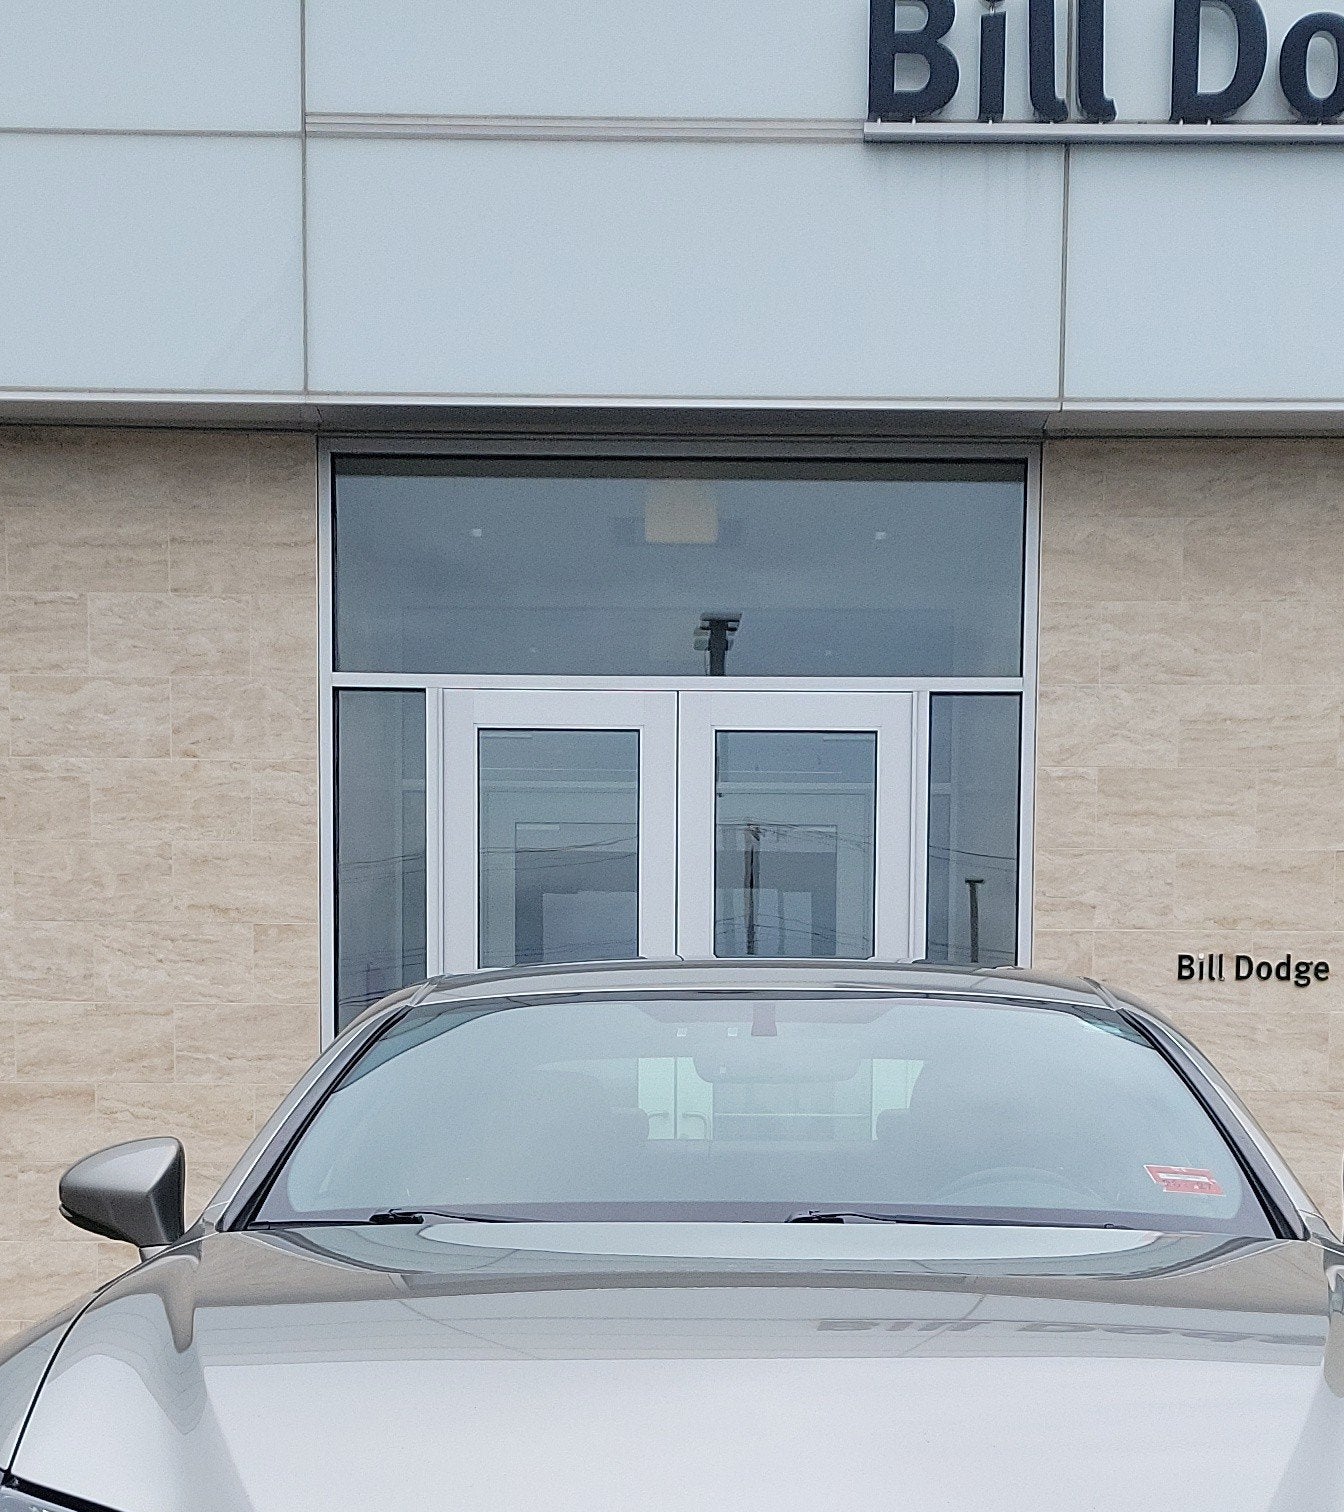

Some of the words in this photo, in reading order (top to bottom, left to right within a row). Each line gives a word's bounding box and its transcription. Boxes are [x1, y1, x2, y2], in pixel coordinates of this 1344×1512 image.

[867, 0, 1117, 123] Bill
[1177, 953, 1225, 981] Bill
[1234, 953, 1330, 988] Dodge
